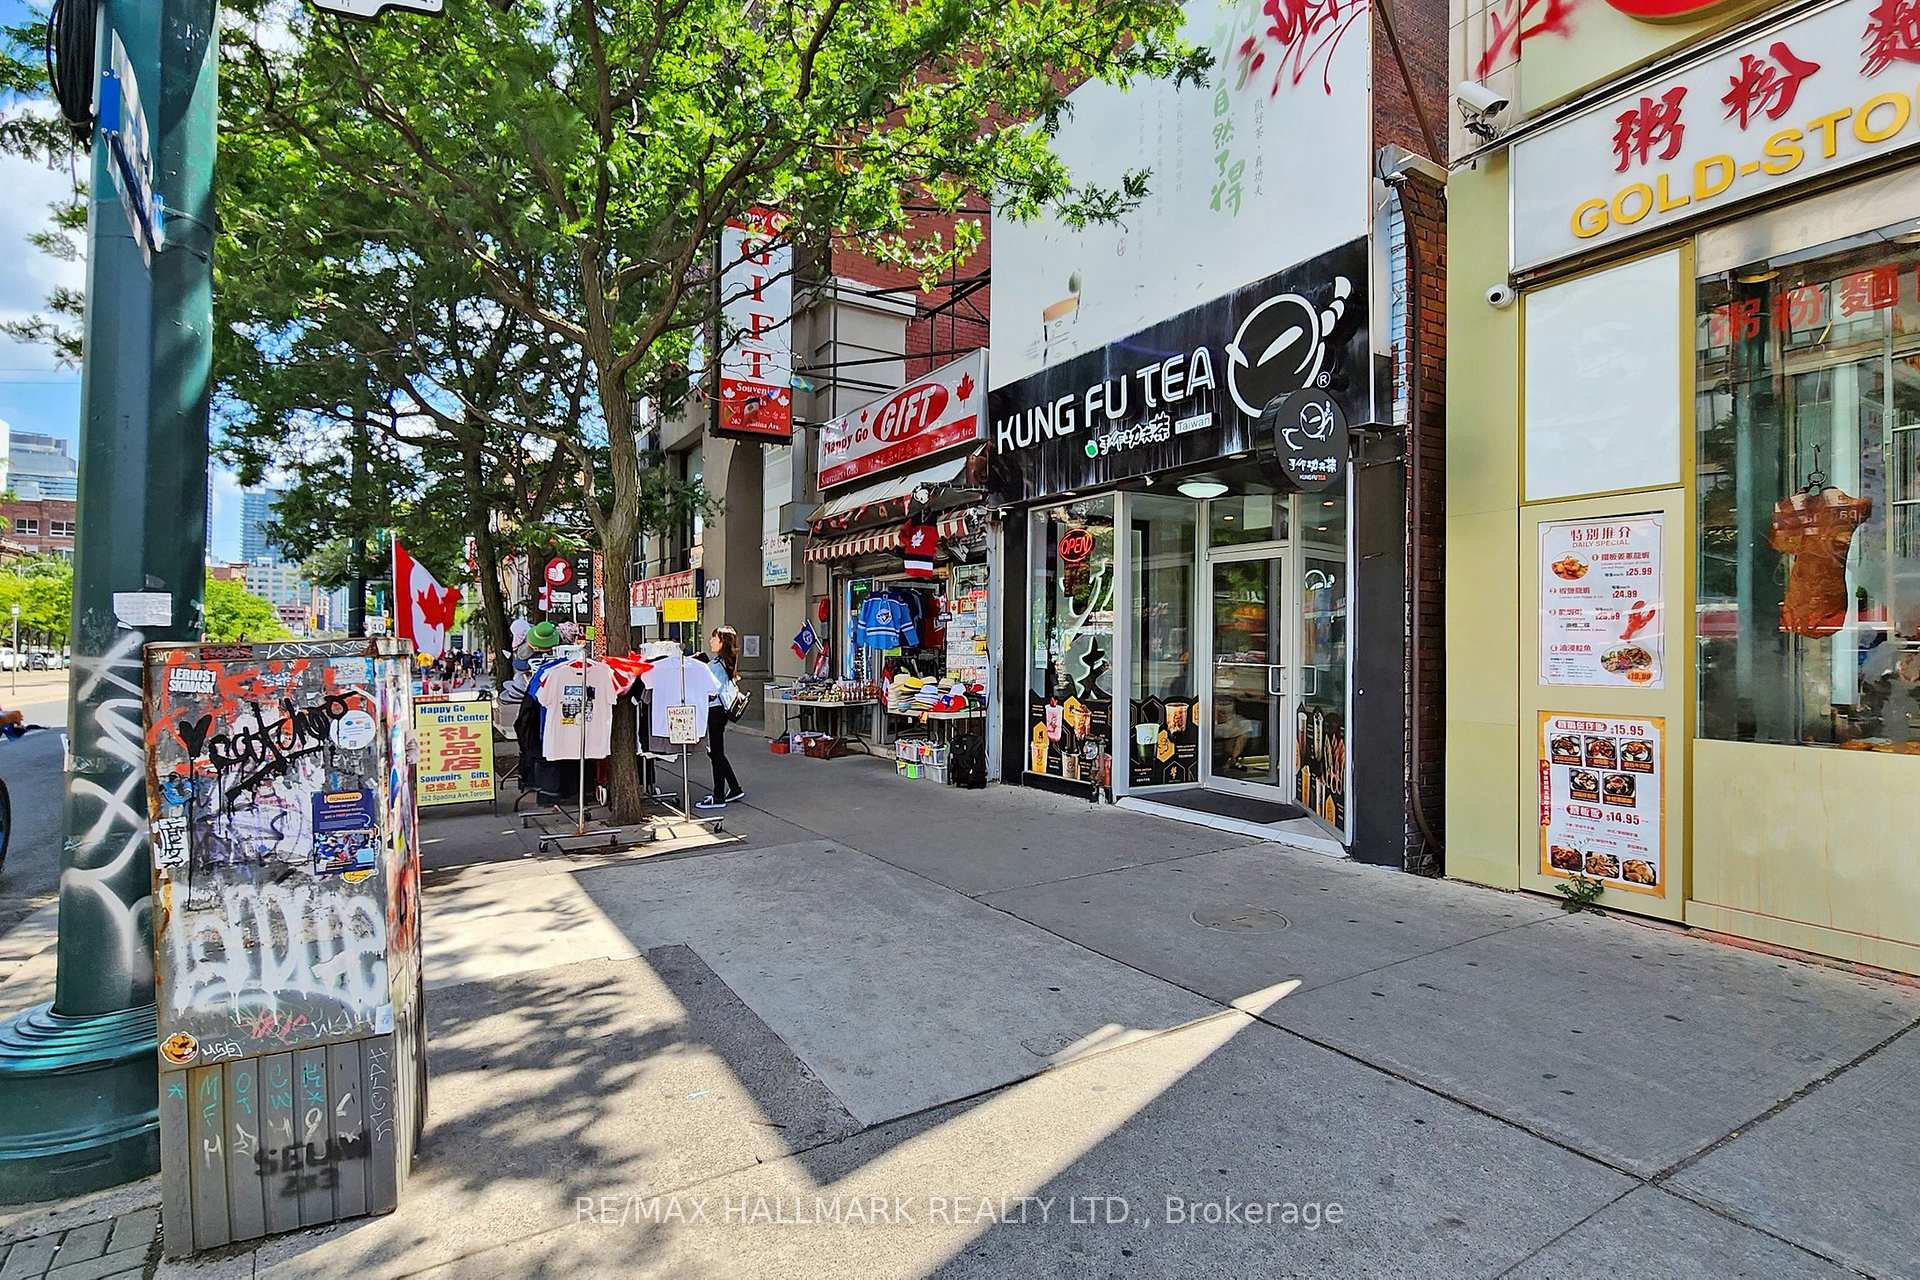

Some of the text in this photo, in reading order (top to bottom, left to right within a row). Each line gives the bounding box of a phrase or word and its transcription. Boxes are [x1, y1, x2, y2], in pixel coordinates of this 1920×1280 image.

[1570, 80, 1920, 239] GOLD-STO
[997, 393, 1075, 455] KUNG
[1085, 374, 1128, 428] FU
[1136, 346, 1216, 408] TEA
[880, 385, 937, 441] GIFT
[1177, 416, 1211, 433] Taiwan
[855, 428, 869, 444] Go
[1061, 535, 1090, 555] OPEN
[1572, 539, 1630, 548] DAILY SPECIAL
[705, 578, 720, 598] 260
[169, 680, 215, 694] SKIMASK
[420, 705, 466, 715] Happy Go
[438, 714, 489, 723] Gift Center
[420, 773, 462, 783] Souvenirs
[1606, 811, 1641, 825] $14.95
